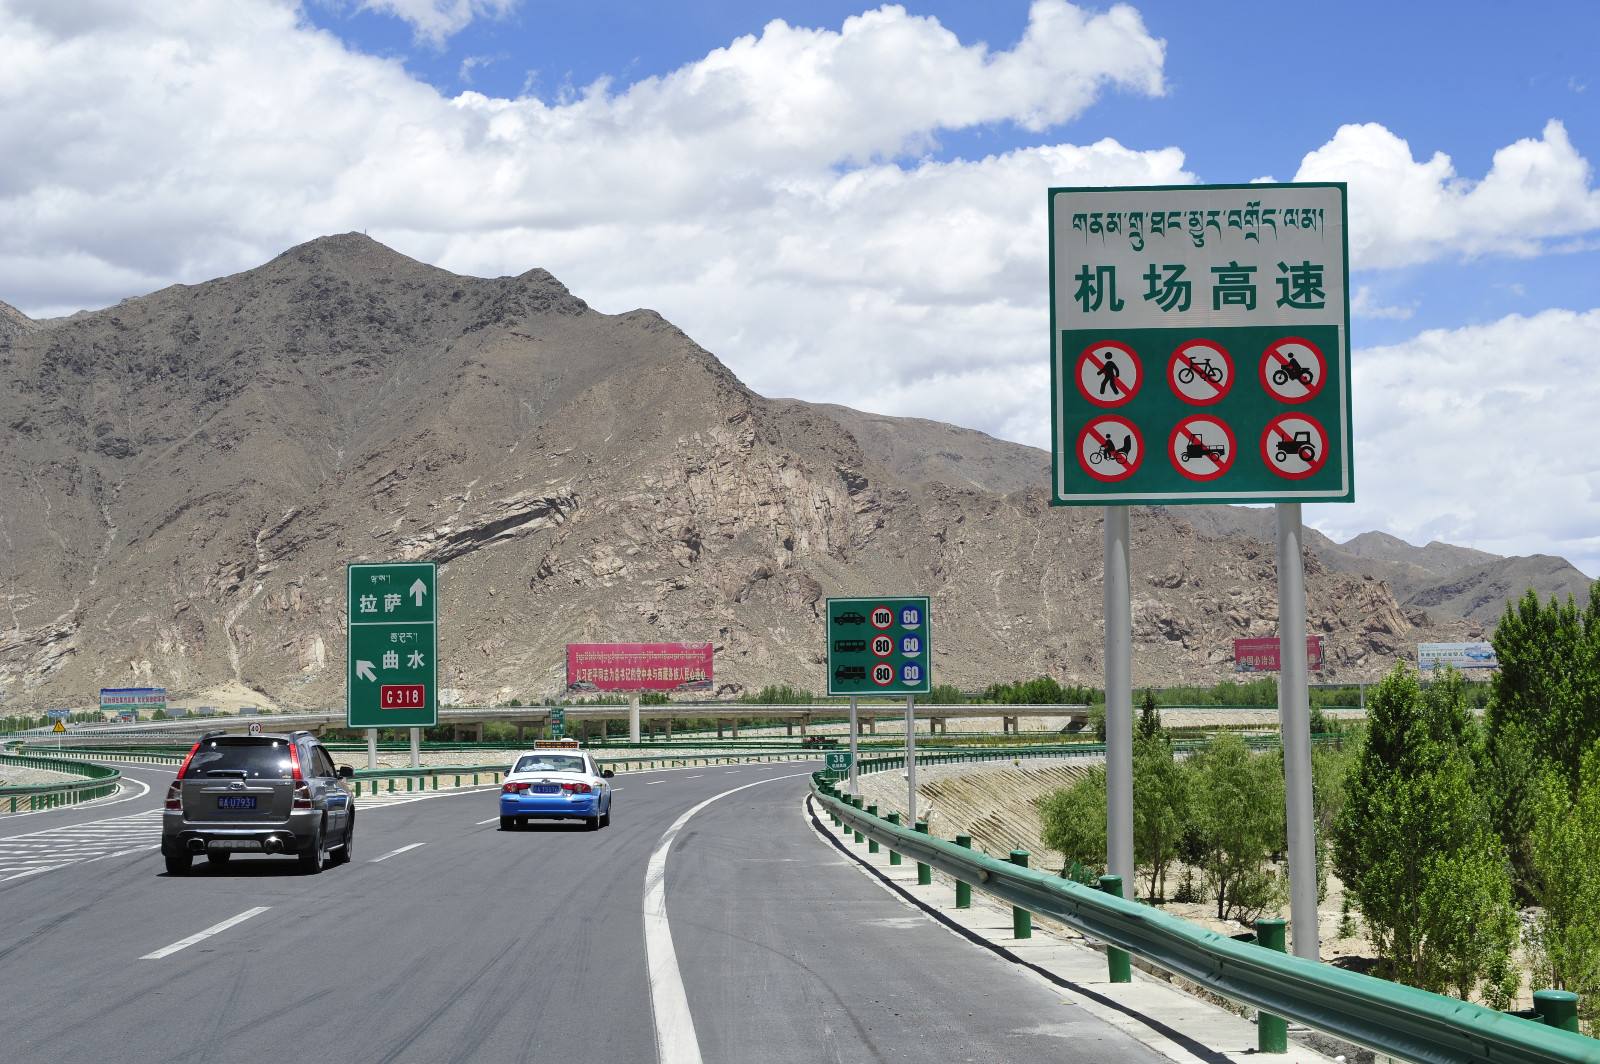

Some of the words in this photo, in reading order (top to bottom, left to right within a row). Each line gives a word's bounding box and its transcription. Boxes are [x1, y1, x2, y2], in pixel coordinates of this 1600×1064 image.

[1074, 261, 1326, 313] 机场高速
[359, 594, 402, 613] 拉萨
[874, 612, 890, 624] 100
[903, 610, 918, 624] 60
[875, 640, 890, 652] 80
[903, 638, 919, 652] 60
[382, 650, 425, 670] 曲水
[876, 668, 890, 681] 80
[904, 666, 919, 680] 60
[386, 690, 419, 704] G318
[833, 754, 845, 763] 38
